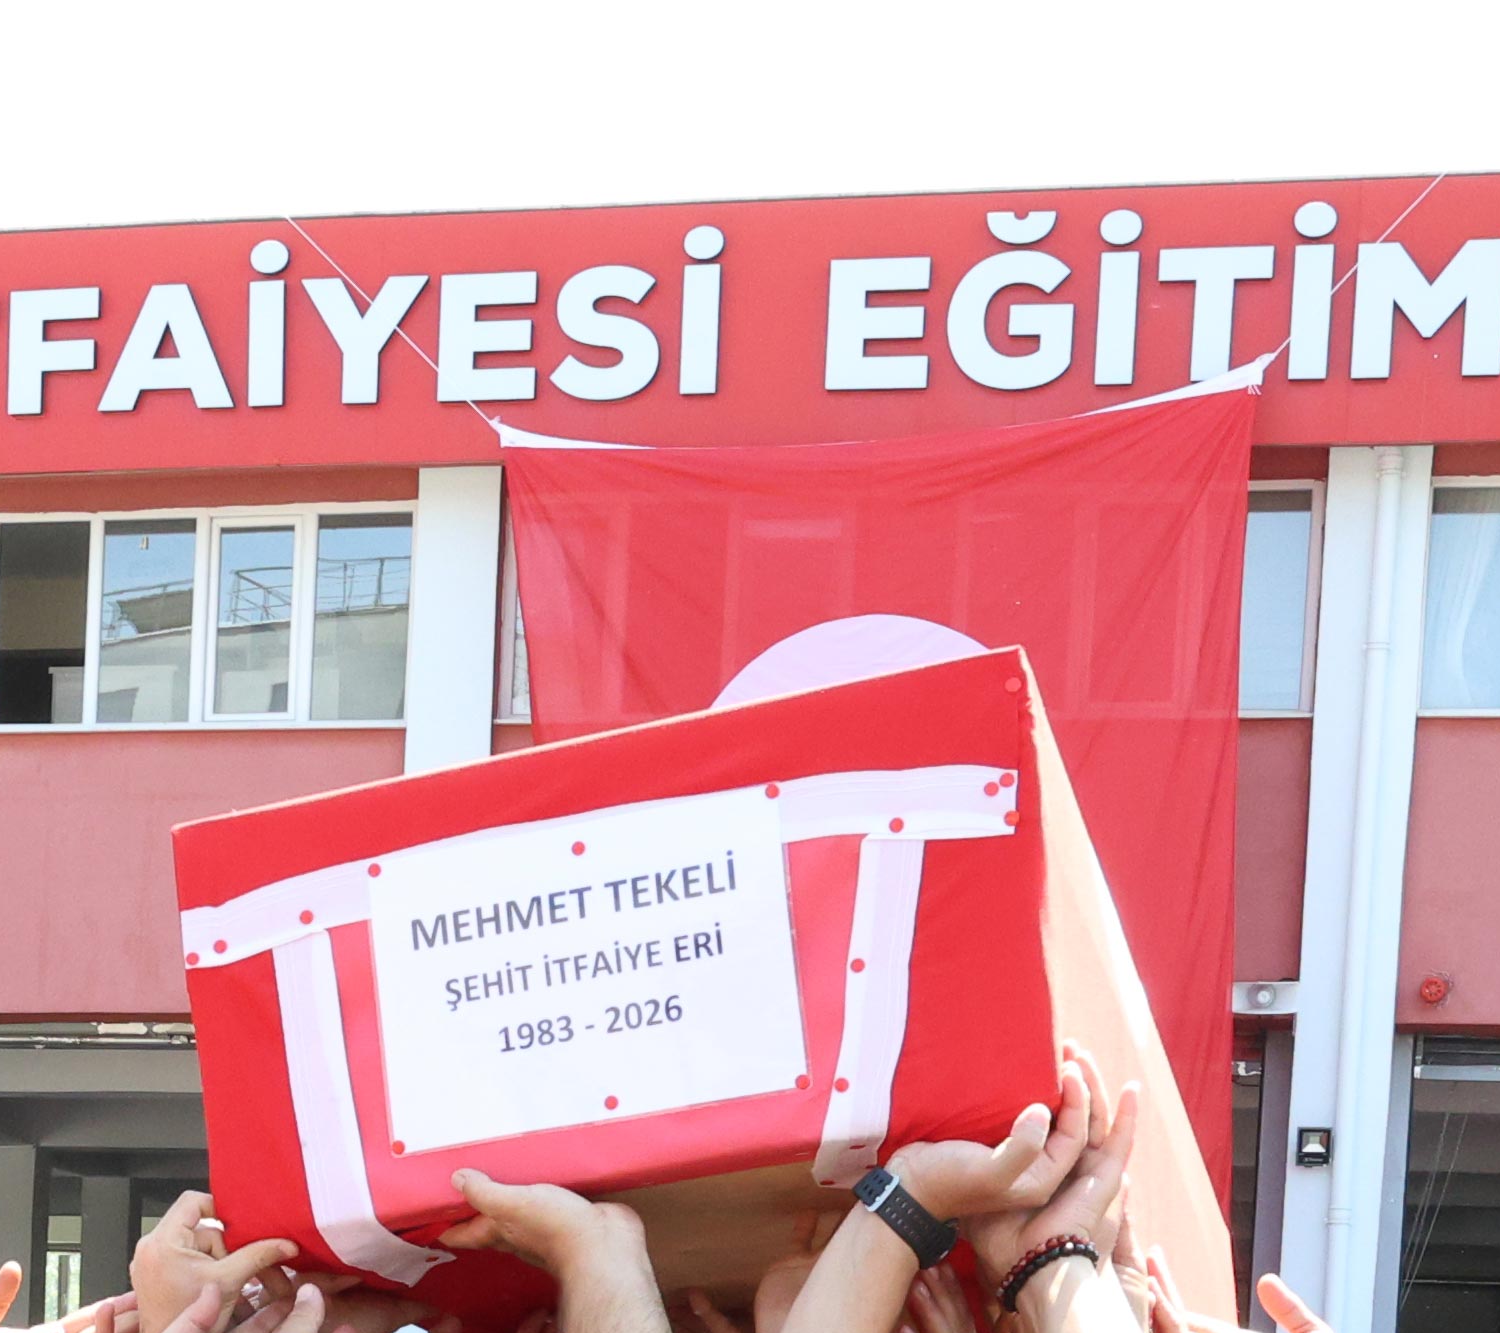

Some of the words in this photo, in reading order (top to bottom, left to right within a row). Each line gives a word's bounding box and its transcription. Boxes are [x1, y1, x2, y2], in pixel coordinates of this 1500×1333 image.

[411, 886, 592, 951] MEHMET
[603, 848, 739, 913] TEKELİ
[445, 961, 533, 1012] ŞEHİT
[543, 940, 663, 988] İTFAİYE
[673, 921, 725, 963] ERİ
[498, 1015, 574, 1053] 1983
[605, 994, 683, 1034] 2026
